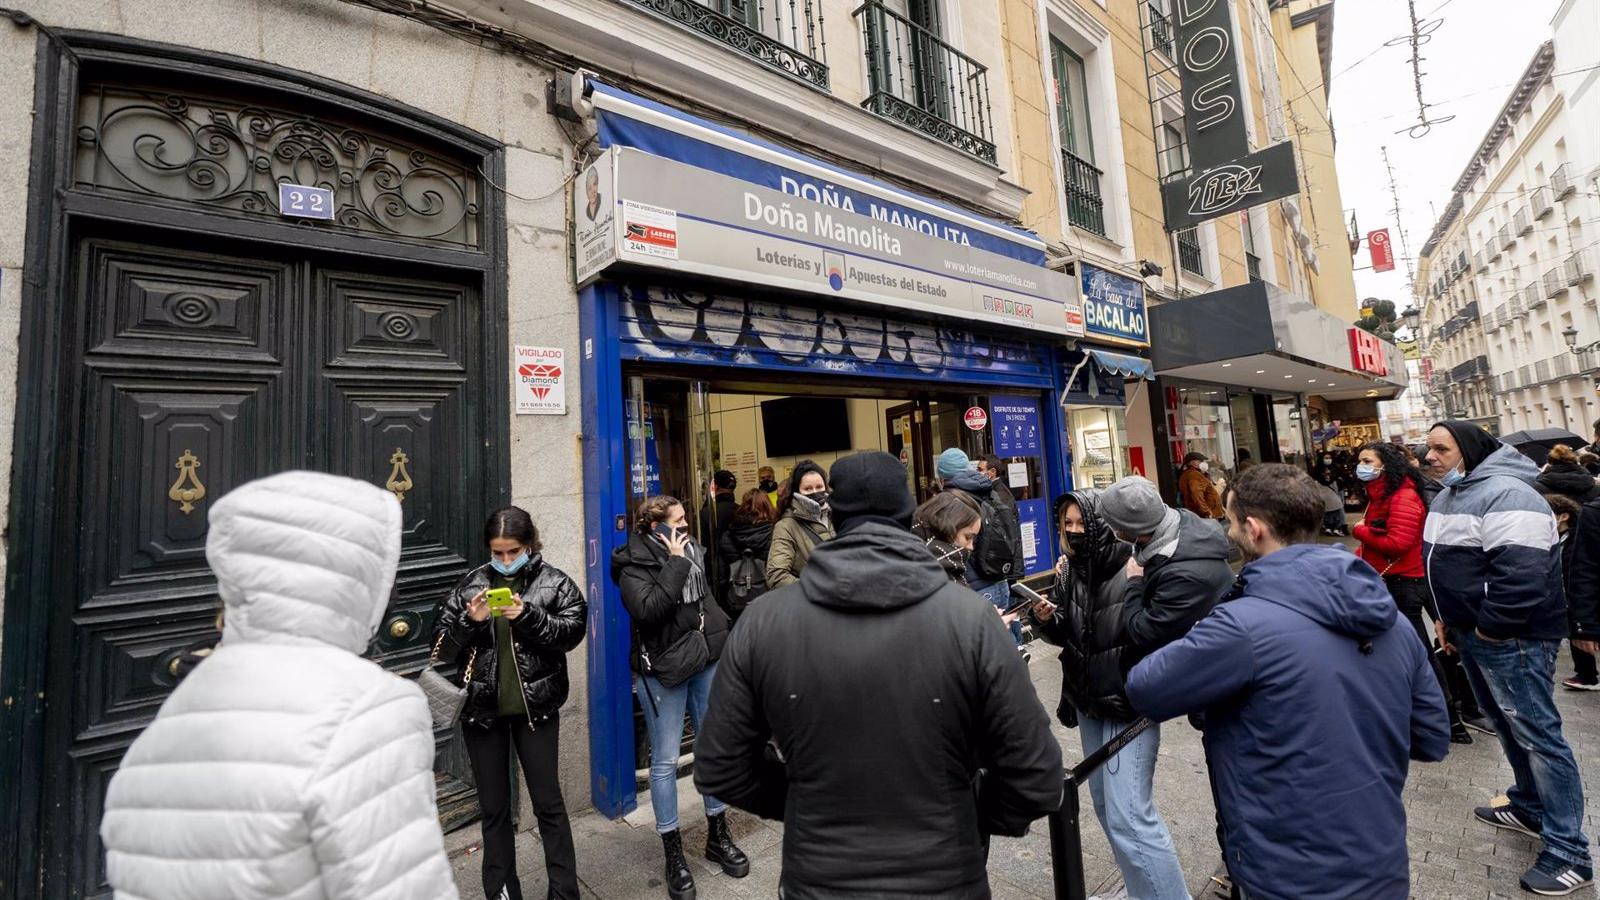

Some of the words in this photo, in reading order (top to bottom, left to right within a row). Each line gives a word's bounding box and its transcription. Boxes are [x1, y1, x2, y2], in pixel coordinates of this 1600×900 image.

[290, 191, 323, 212] 22
[780, 175, 856, 214] DOÑA
[870, 203, 971, 247] MANOLITA
[743, 192, 808, 233] Doña
[814, 211, 902, 256] Manolita
[630, 241, 646, 252] 24h
[756, 247, 811, 270] Loterías
[813, 260, 822, 276] y
[848, 266, 897, 288] Apuestas
[899, 277, 915, 291] del
[916, 279, 947, 298] Estado
[944, 259, 1037, 289] www.loteriamanolita.com
[1088, 278, 1102, 299] La
[1103, 281, 1123, 306] Casa
[1125, 293, 1137, 309] del
[1085, 301, 1144, 335] BACALAO
[519, 349, 562, 358] VIGILADO
